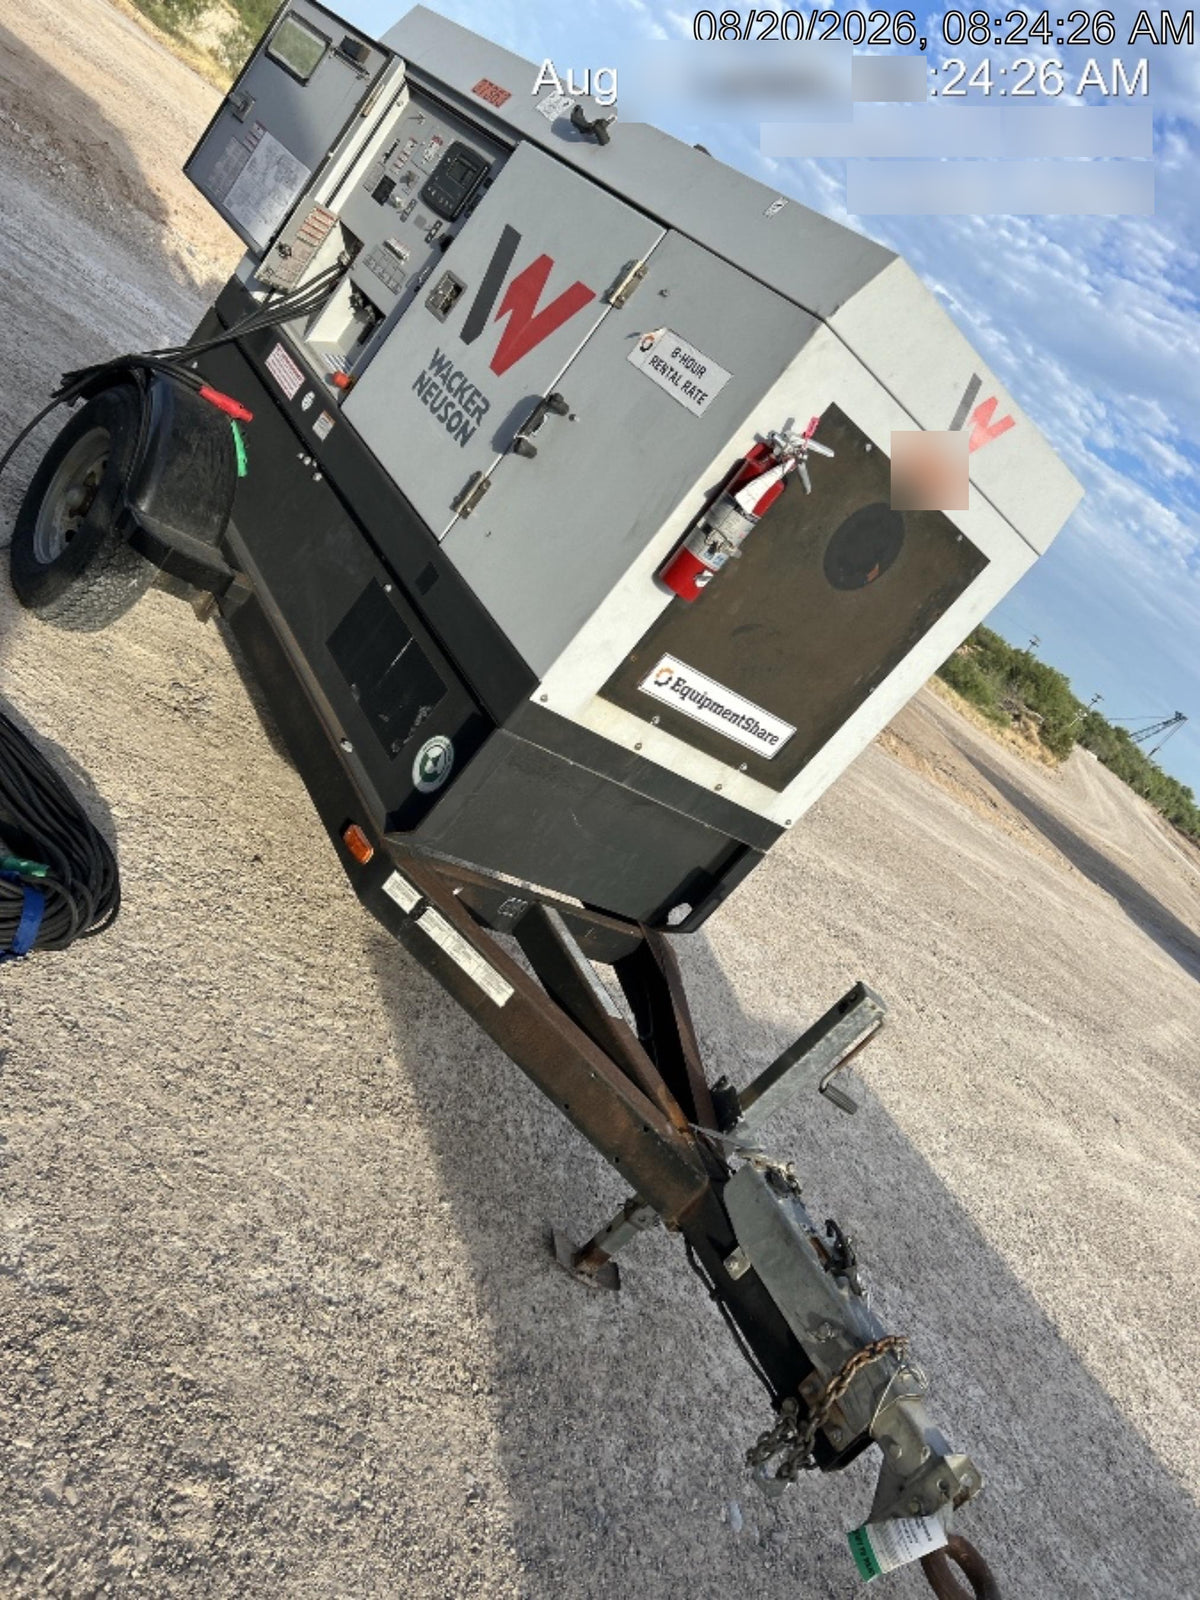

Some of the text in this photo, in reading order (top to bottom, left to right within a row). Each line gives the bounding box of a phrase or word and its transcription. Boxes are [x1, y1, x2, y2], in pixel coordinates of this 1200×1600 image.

[427, 346, 491, 427] WACKER
[648, 354, 709, 406] RENTAL RATE
[670, 346, 707, 380] 8-HOUR
[411, 369, 477, 448] NEUSON
[670, 676, 780, 747] EquipmentShare
